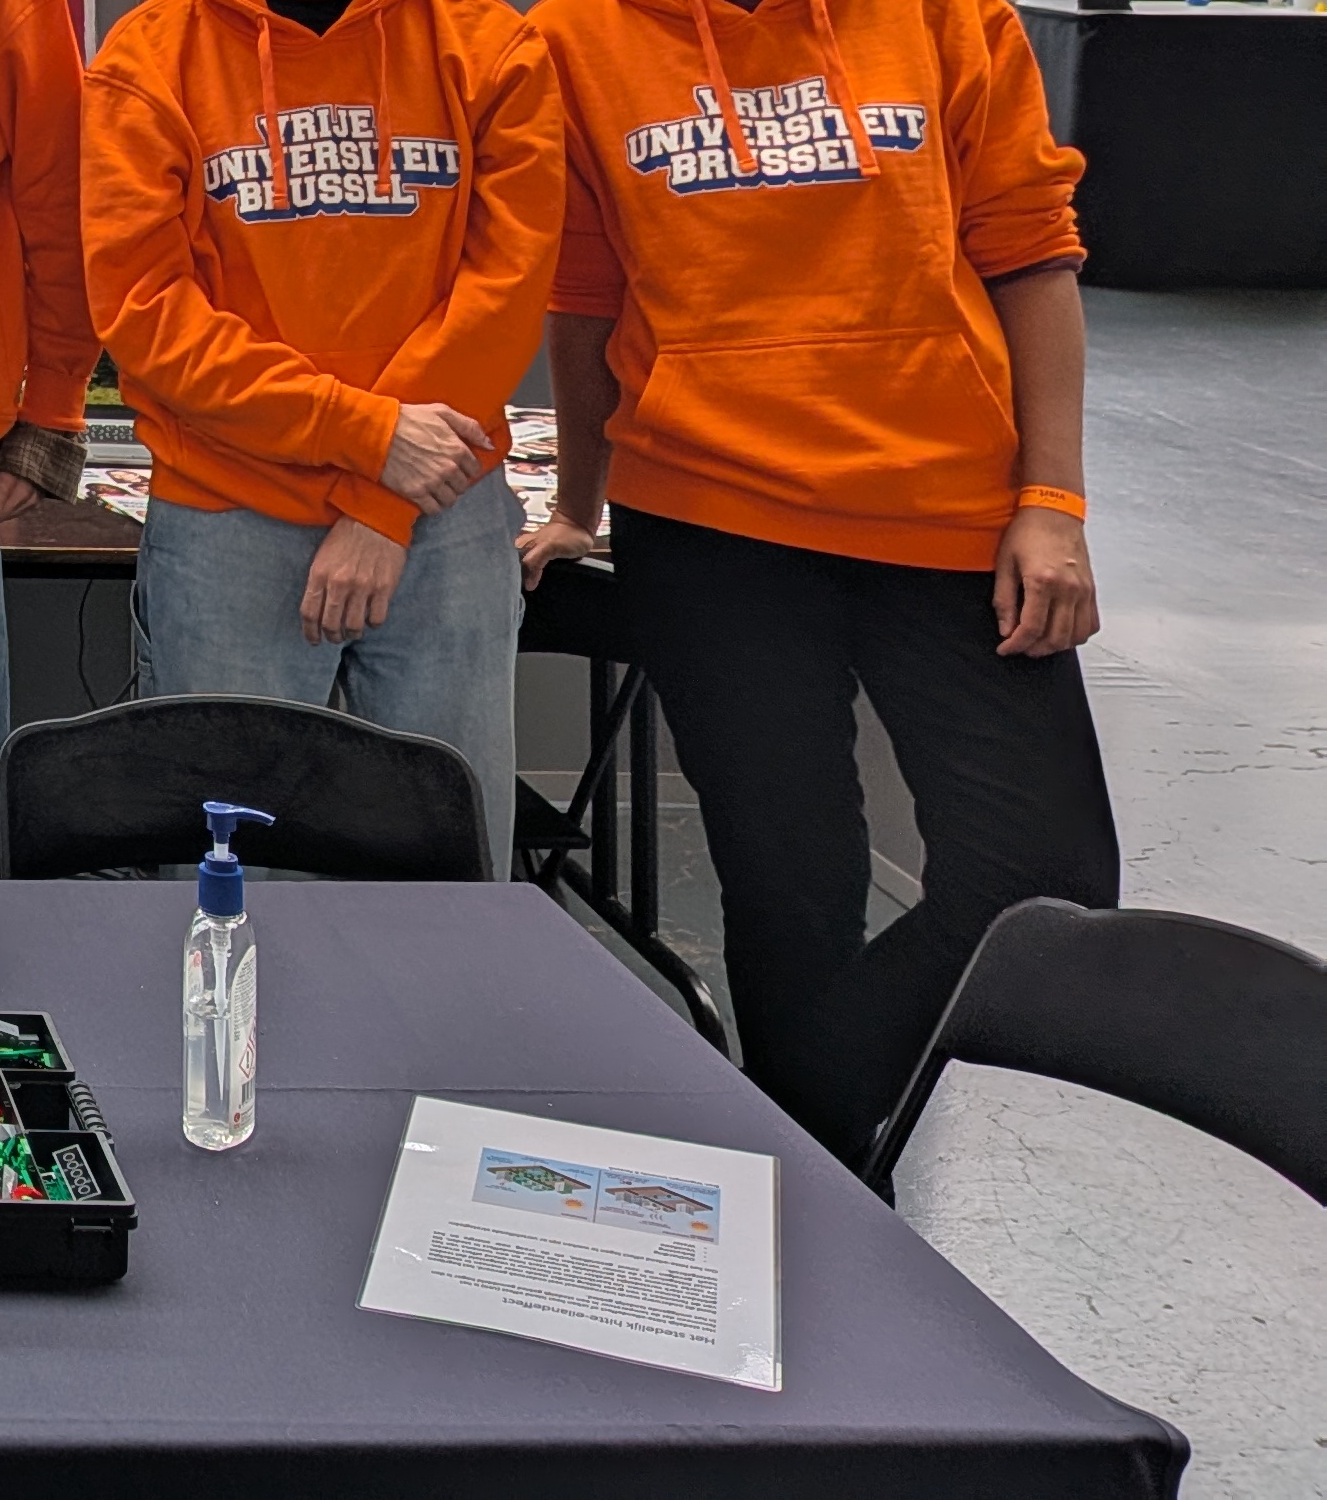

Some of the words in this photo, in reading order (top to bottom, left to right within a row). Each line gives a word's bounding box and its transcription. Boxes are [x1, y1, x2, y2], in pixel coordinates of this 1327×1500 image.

[501, 1296, 624, 1331] hitte-eilandeffect
[626, 1321, 686, 1340] stedelijk
[688, 1333, 716, 1346] Het
